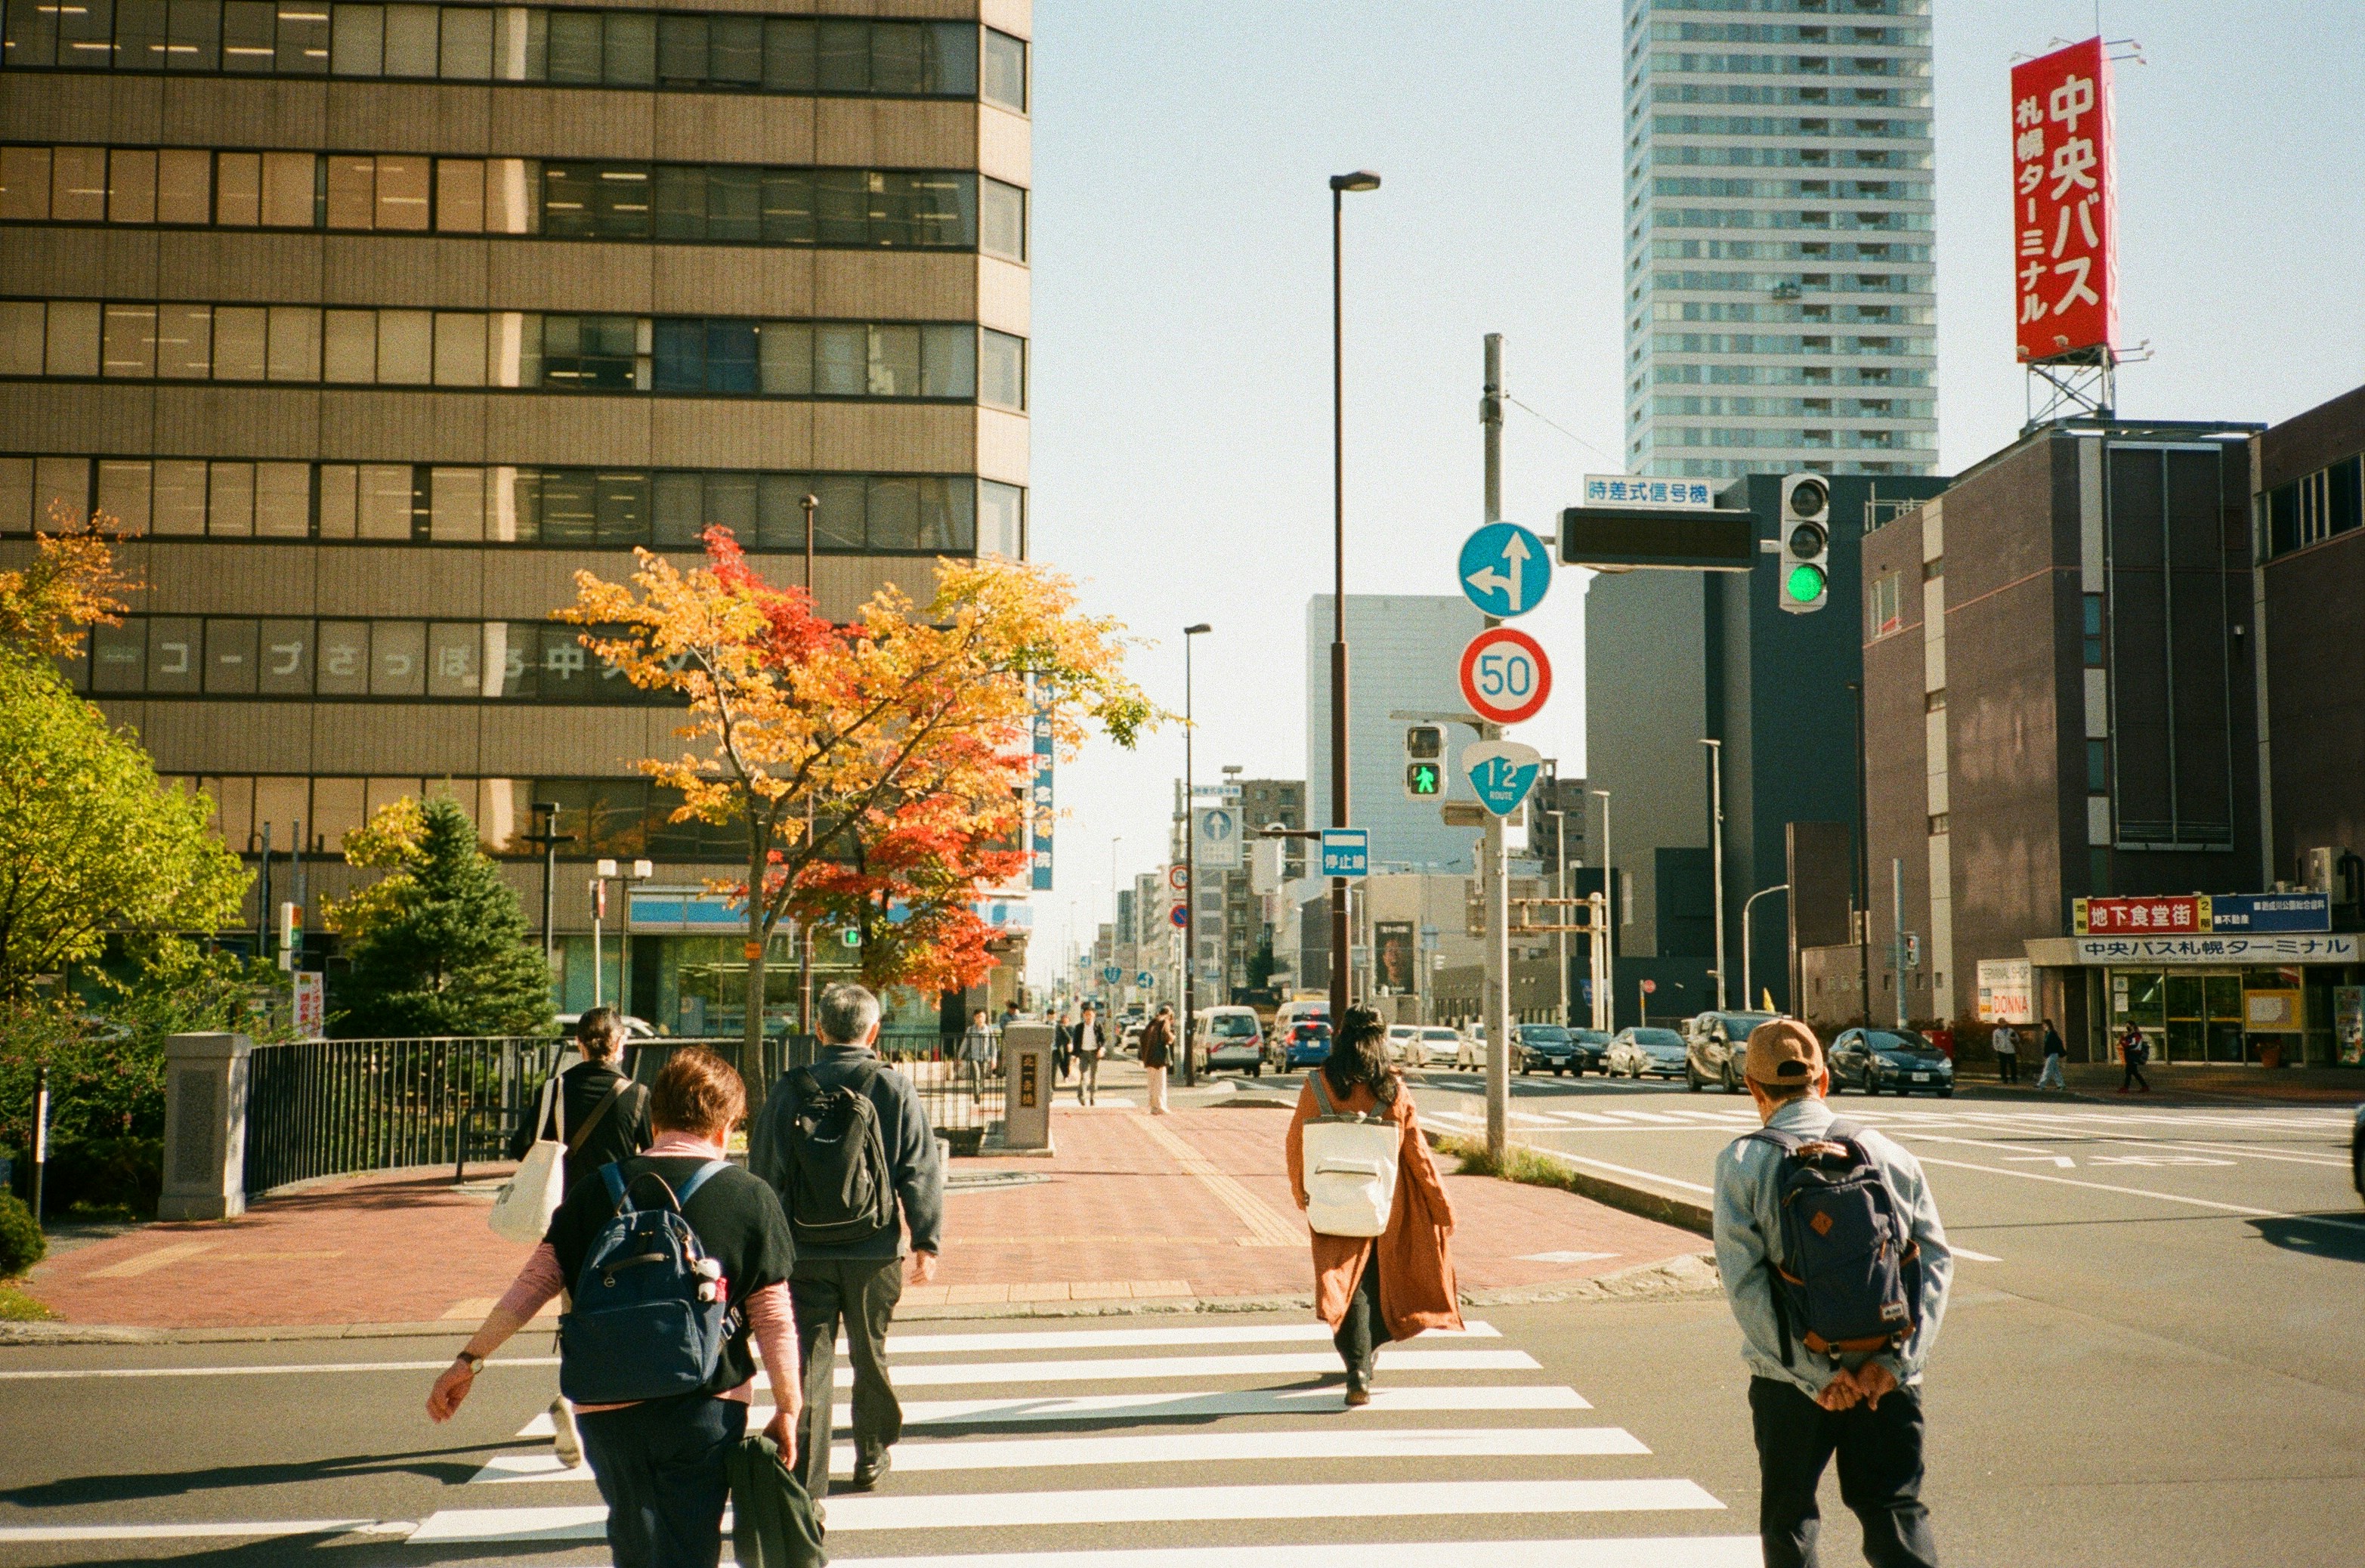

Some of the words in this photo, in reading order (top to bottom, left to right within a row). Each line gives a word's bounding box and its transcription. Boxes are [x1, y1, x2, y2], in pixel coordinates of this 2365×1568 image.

[2049, 74, 2099, 316] 中央バス
[2017, 95, 2048, 324] 札幌ターミナル
[1588, 481, 1707, 503] 時差式信号機
[1482, 655, 1530, 696] 50
[1489, 760, 1517, 787] 12
[1325, 854, 1365, 869] 停止線
[2091, 904, 2190, 926] 地下食堂街
[2085, 939, 2351, 956] 中央バス札幌ターミナル
[1994, 995, 2029, 1013] DONNA
